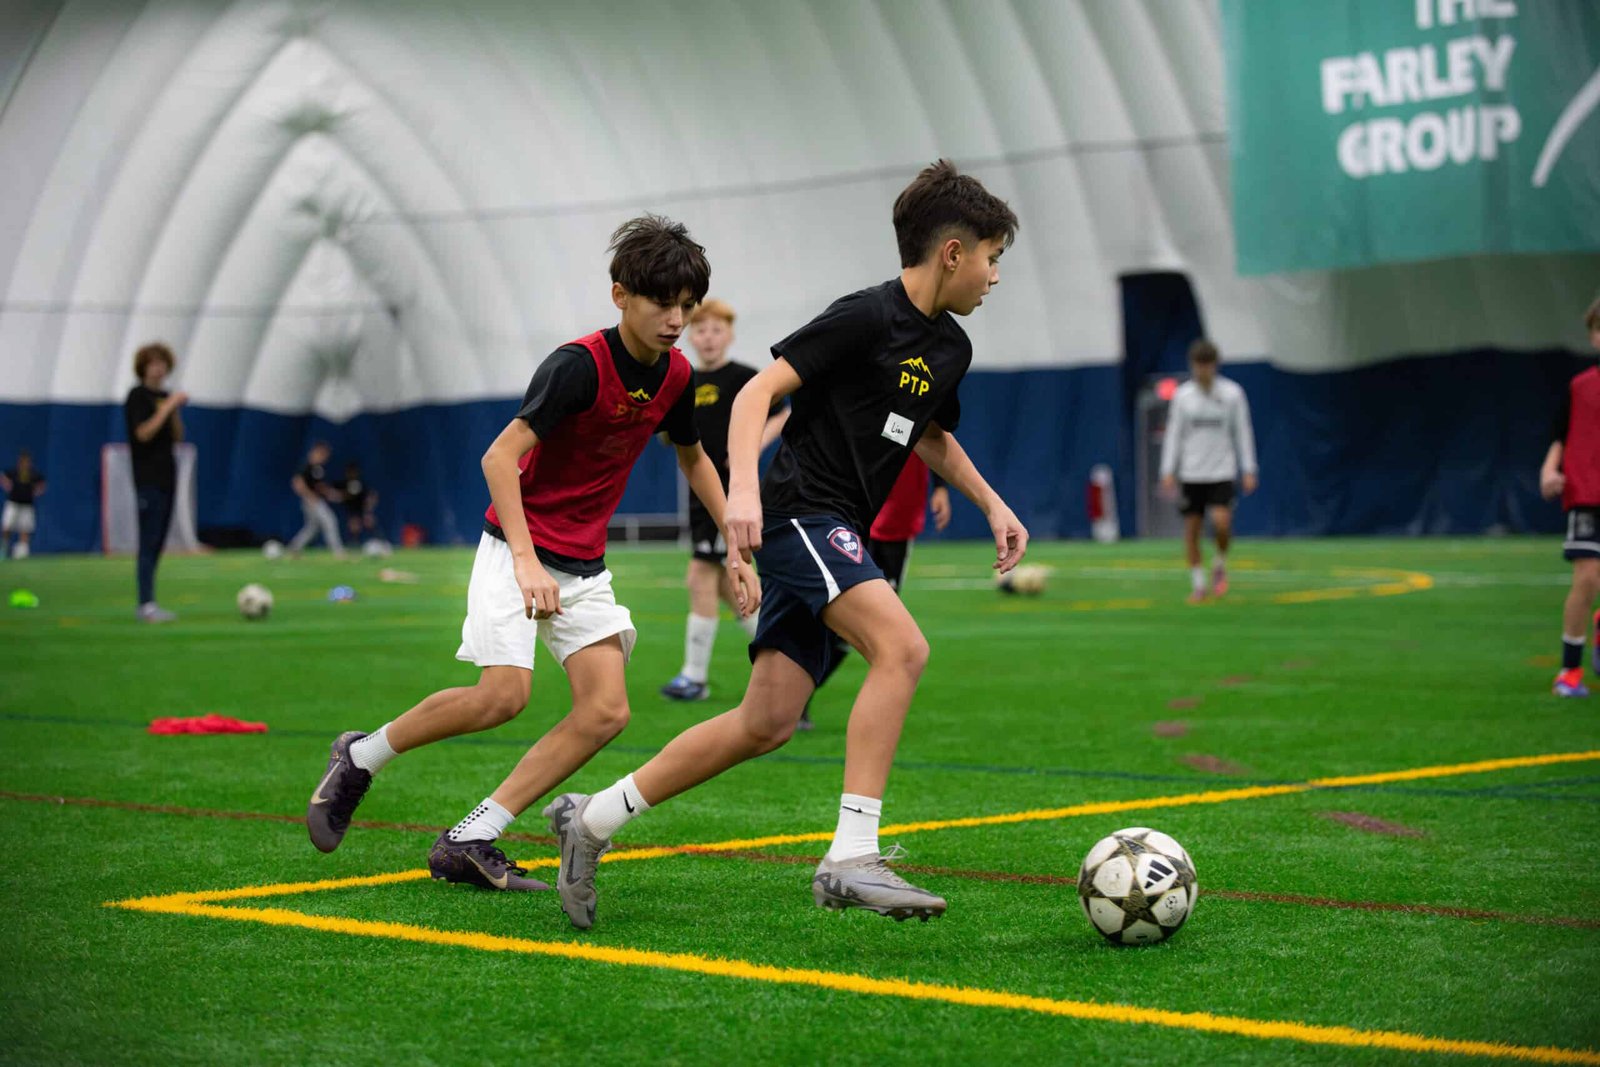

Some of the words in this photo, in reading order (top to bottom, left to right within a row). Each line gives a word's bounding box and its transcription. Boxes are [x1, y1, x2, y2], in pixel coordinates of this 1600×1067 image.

[1320, 35, 1515, 114] FARLEY
[1337, 105, 1521, 178] GROUP
[899, 371, 930, 396] PTP
